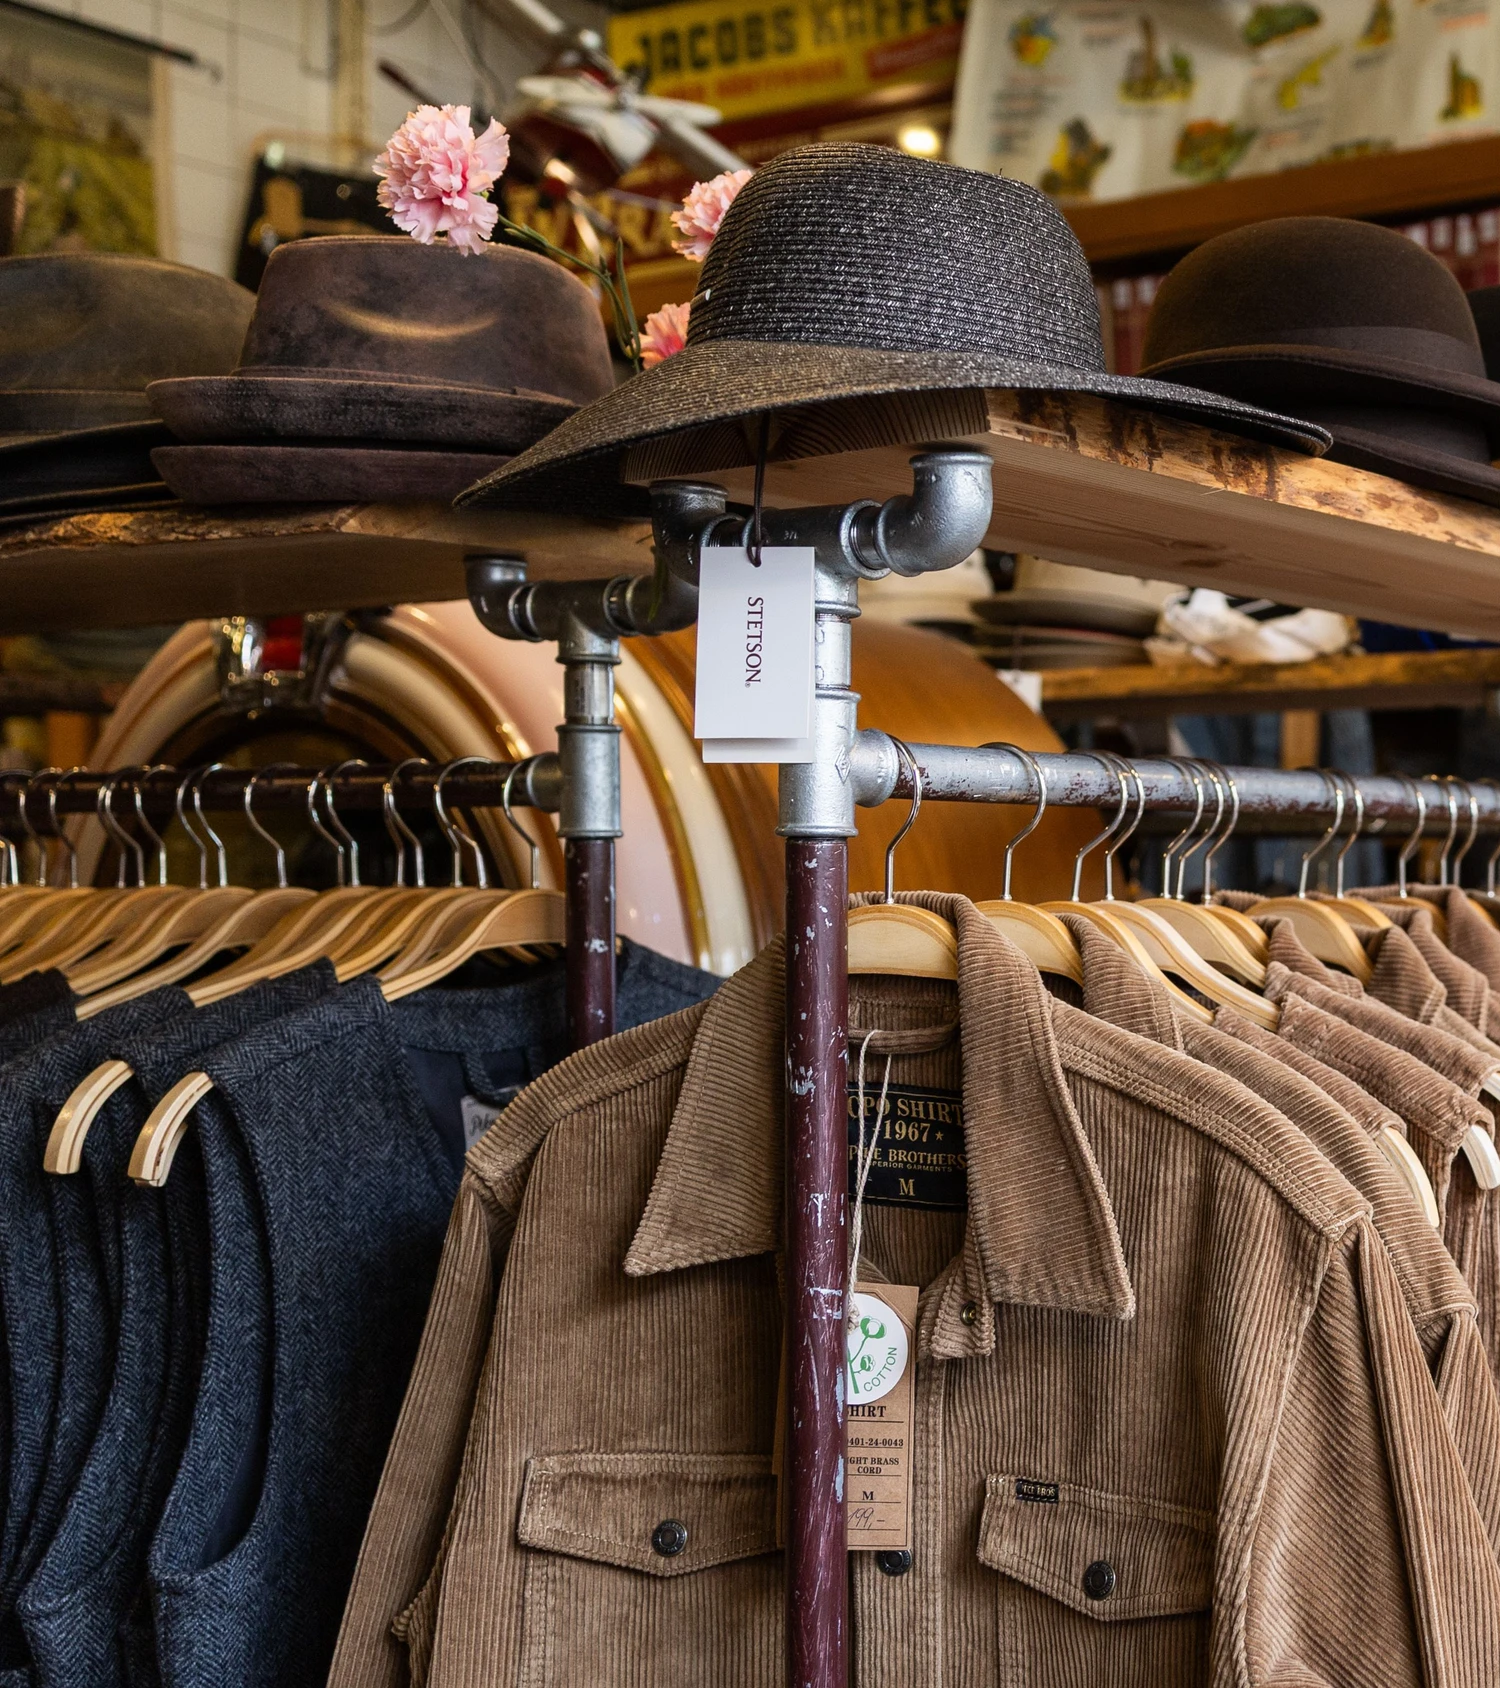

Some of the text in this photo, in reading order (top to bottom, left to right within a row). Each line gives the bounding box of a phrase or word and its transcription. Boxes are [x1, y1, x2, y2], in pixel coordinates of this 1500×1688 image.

[626, 5, 797, 84] JACOBS
[848, 1095, 964, 1127] CPO SHIRT
[883, 1119, 931, 1143] 1967
[848, 1145, 968, 1170] PE BROTHERS
[863, 1160, 953, 1173] PERIOR GARMENTS
[898, 1178, 916, 1197] M
[863, 1346, 898, 1392] COTTON
[847, 1405, 887, 1418] HIRT
[847, 1437, 904, 1447] 401-24-0043
[870, 1457, 900, 1466] BRASS
[857, 1466, 882, 1475] CORD
[862, 1490, 874, 1501] M
